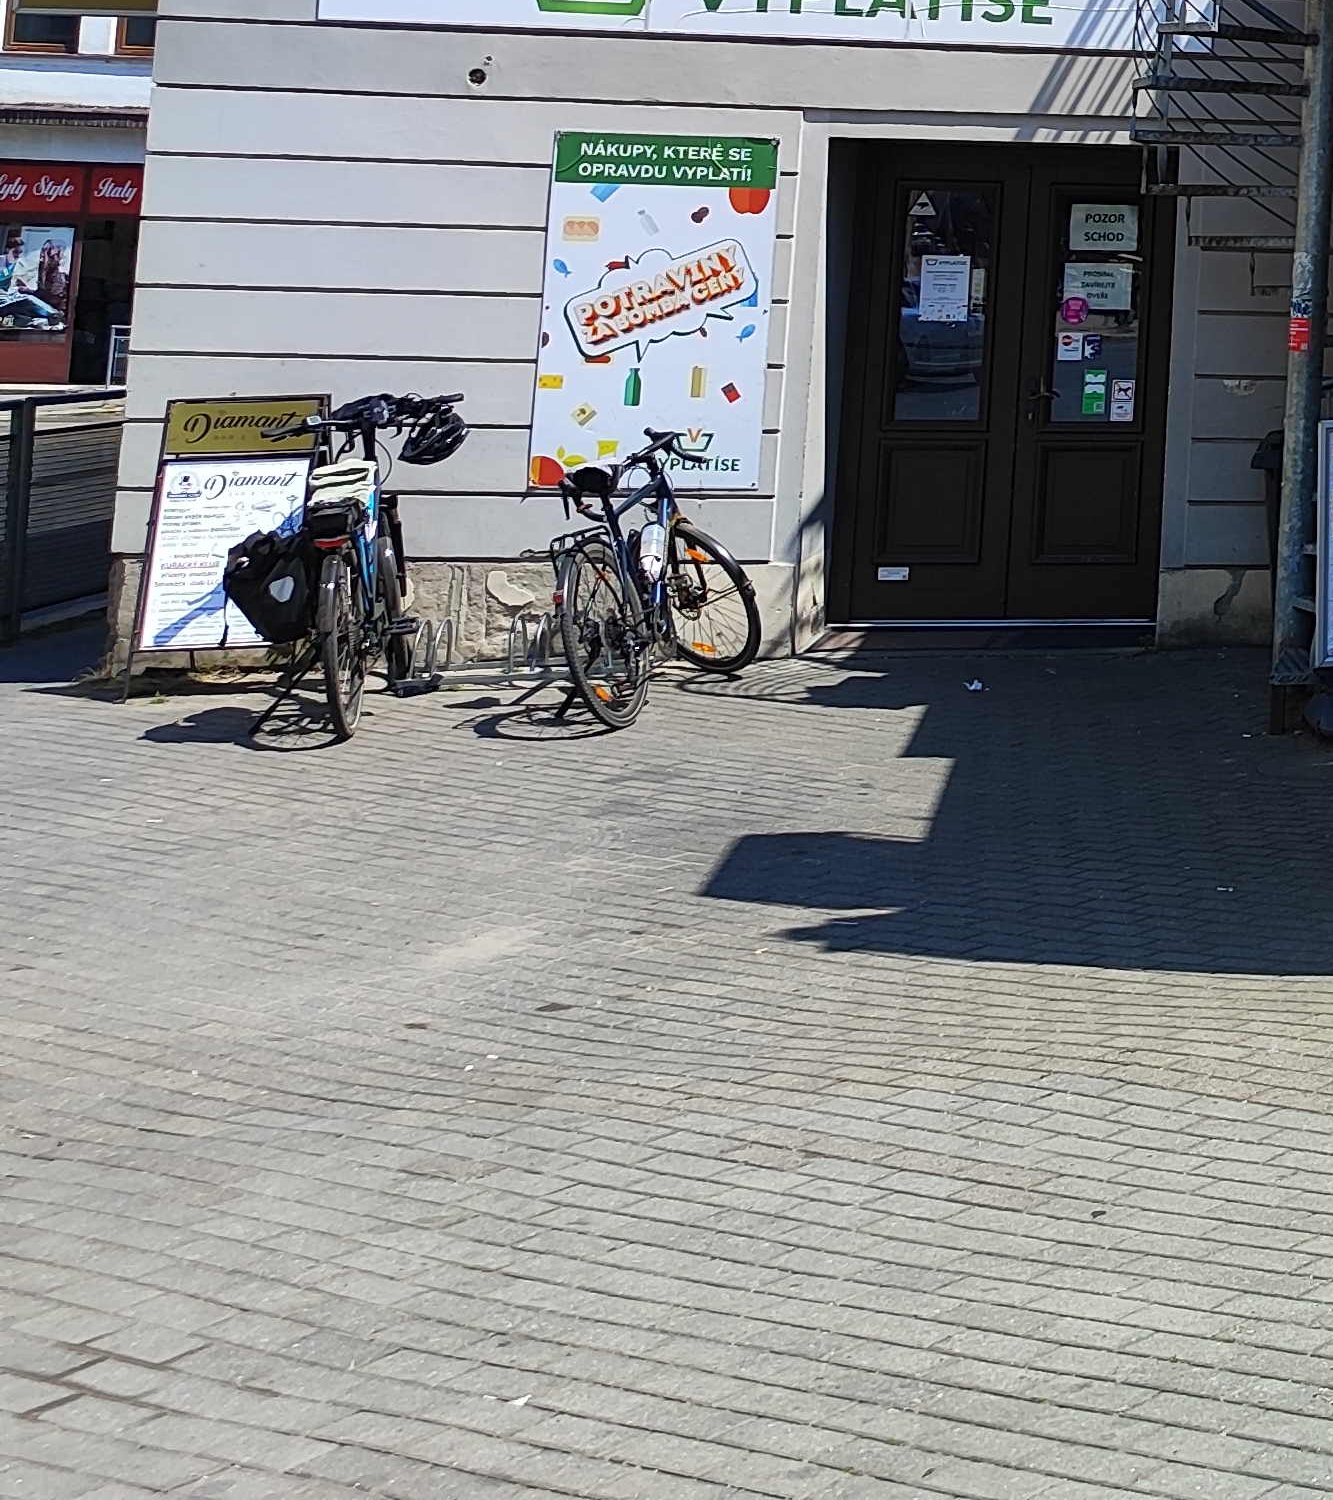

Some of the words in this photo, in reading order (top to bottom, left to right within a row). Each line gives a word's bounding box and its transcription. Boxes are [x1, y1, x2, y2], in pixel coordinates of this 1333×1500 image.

[580, 140, 657, 160] NÁKUPY,
[664, 142, 724, 160] KTERÉ
[728, 148, 753, 161] SE
[578, 162, 667, 178] OPRAVDU
[673, 165, 752, 182] VYPLATÍ!
[32, 174, 75, 202] Style
[94, 177, 138, 204] Italy
[1085, 213, 1126, 224] POZOR
[1084, 231, 1125, 242] SCHOD
[574, 244, 737, 326] POTRAVINY
[614, 290, 691, 331] BOMBA
[691, 266, 745, 305] CENY
[183, 411, 303, 444] Diamant
[658, 455, 741, 472] YPLATÍSE
[203, 472, 303, 501] Diamant
